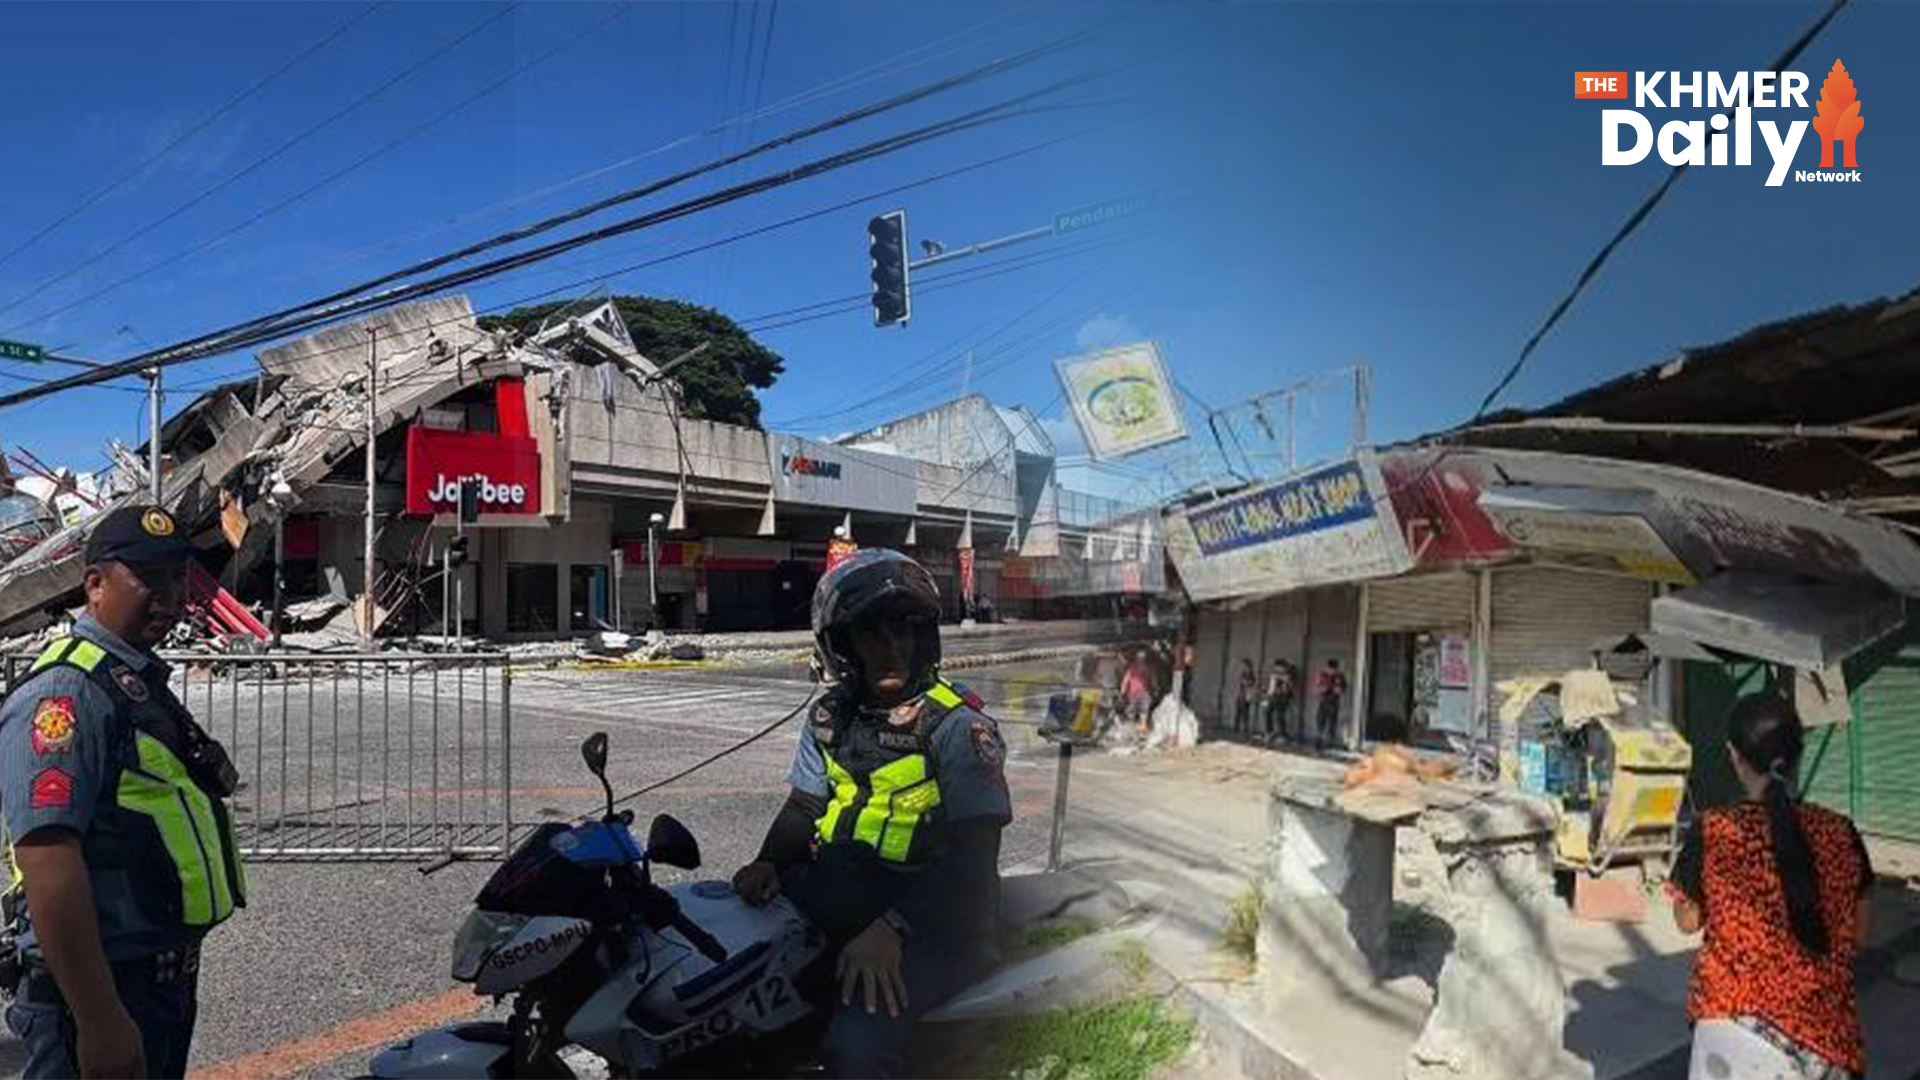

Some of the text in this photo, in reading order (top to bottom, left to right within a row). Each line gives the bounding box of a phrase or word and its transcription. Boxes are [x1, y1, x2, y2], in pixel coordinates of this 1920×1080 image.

[1058, 197, 1147, 231] Pendatun
[428, 473, 525, 504] Jobee
[492, 921, 588, 969] GSCPO-MPU
[745, 976, 791, 1018] 12
